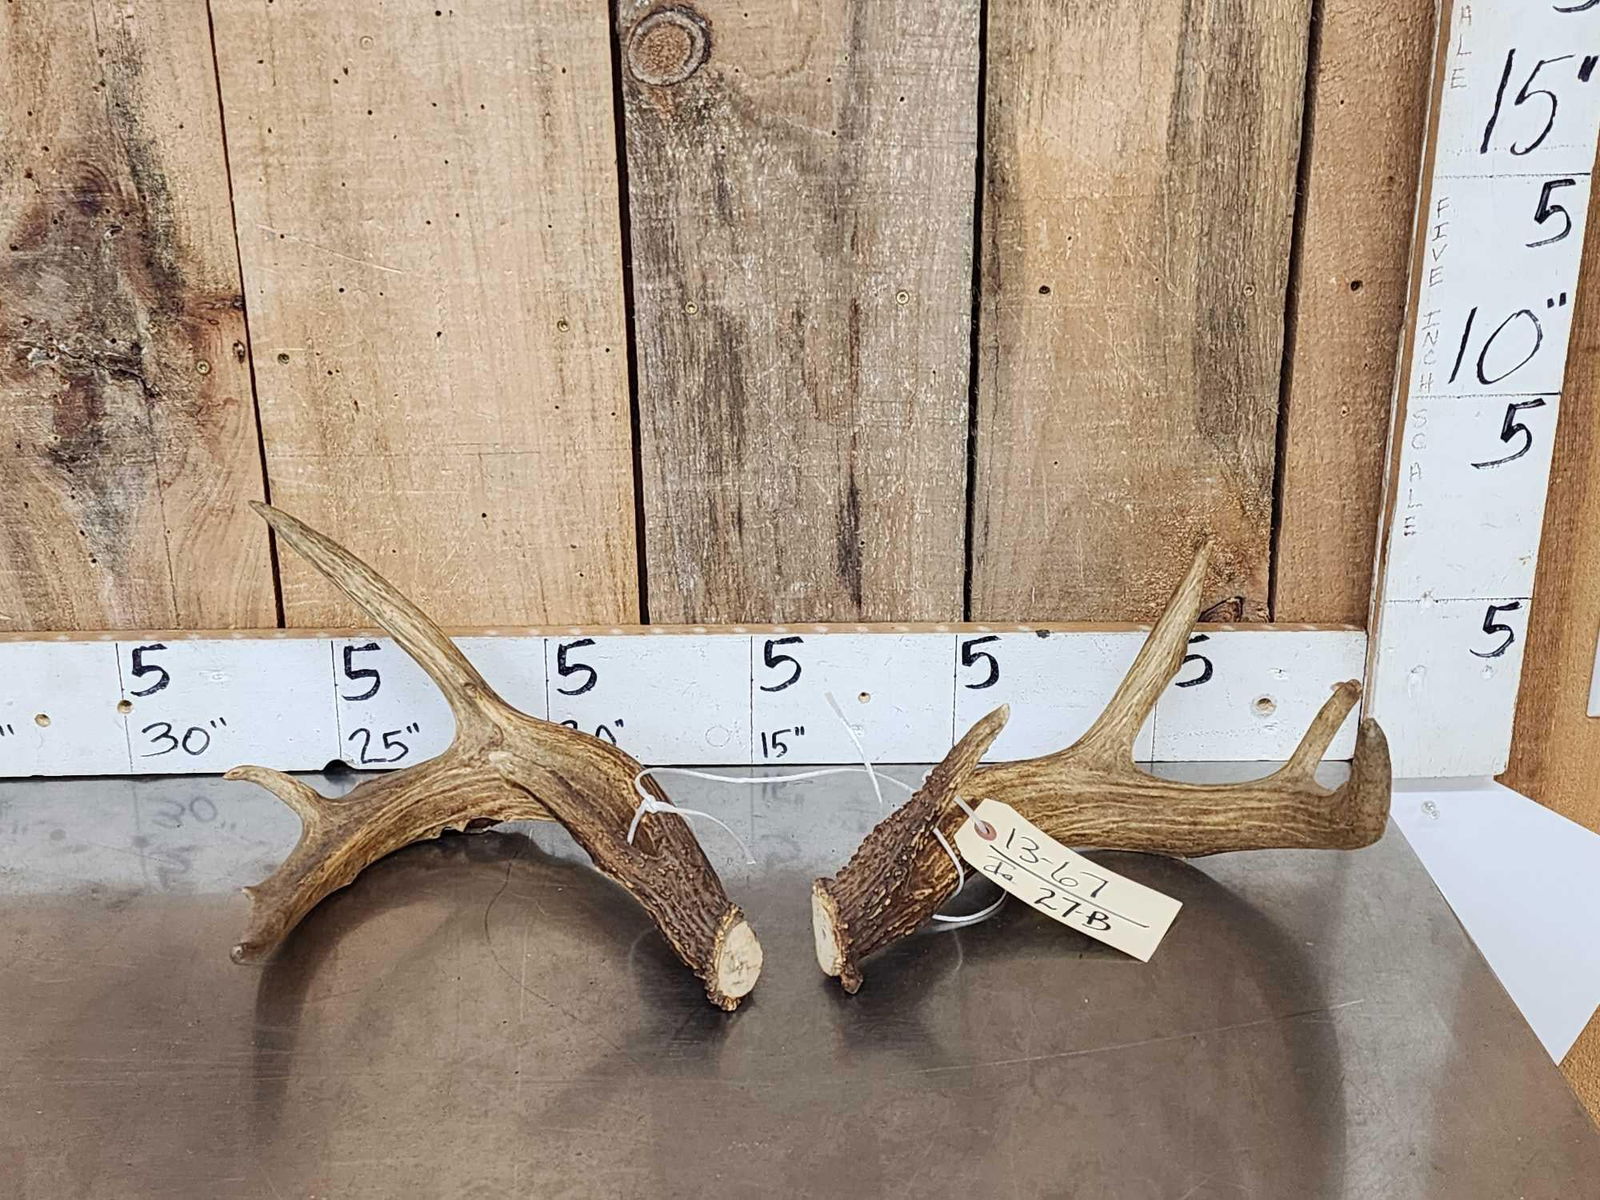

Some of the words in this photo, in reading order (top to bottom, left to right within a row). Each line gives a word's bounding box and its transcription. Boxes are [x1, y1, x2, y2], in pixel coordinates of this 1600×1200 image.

[1480, 48, 1598, 155] 15"
[1428, 197, 1450, 287] FIVE
[1525, 178, 1576, 248] 5
[1418, 309, 1442, 393] INCH
[1448, 292, 1567, 385] 10"
[1470, 398, 1547, 469] 5
[1469, 601, 1521, 659] 5
[130, 643, 170, 697] 5
[342, 642, 382, 701] 5
[556, 637, 598, 695] 5
[760, 635, 805, 692] 5
[960, 635, 1001, 689] 5
[141, 717, 227, 757] 30"
[348, 722, 419, 764] 25"
[761, 726, 806, 758] 15"
[1005, 827, 1110, 898] 13-67
